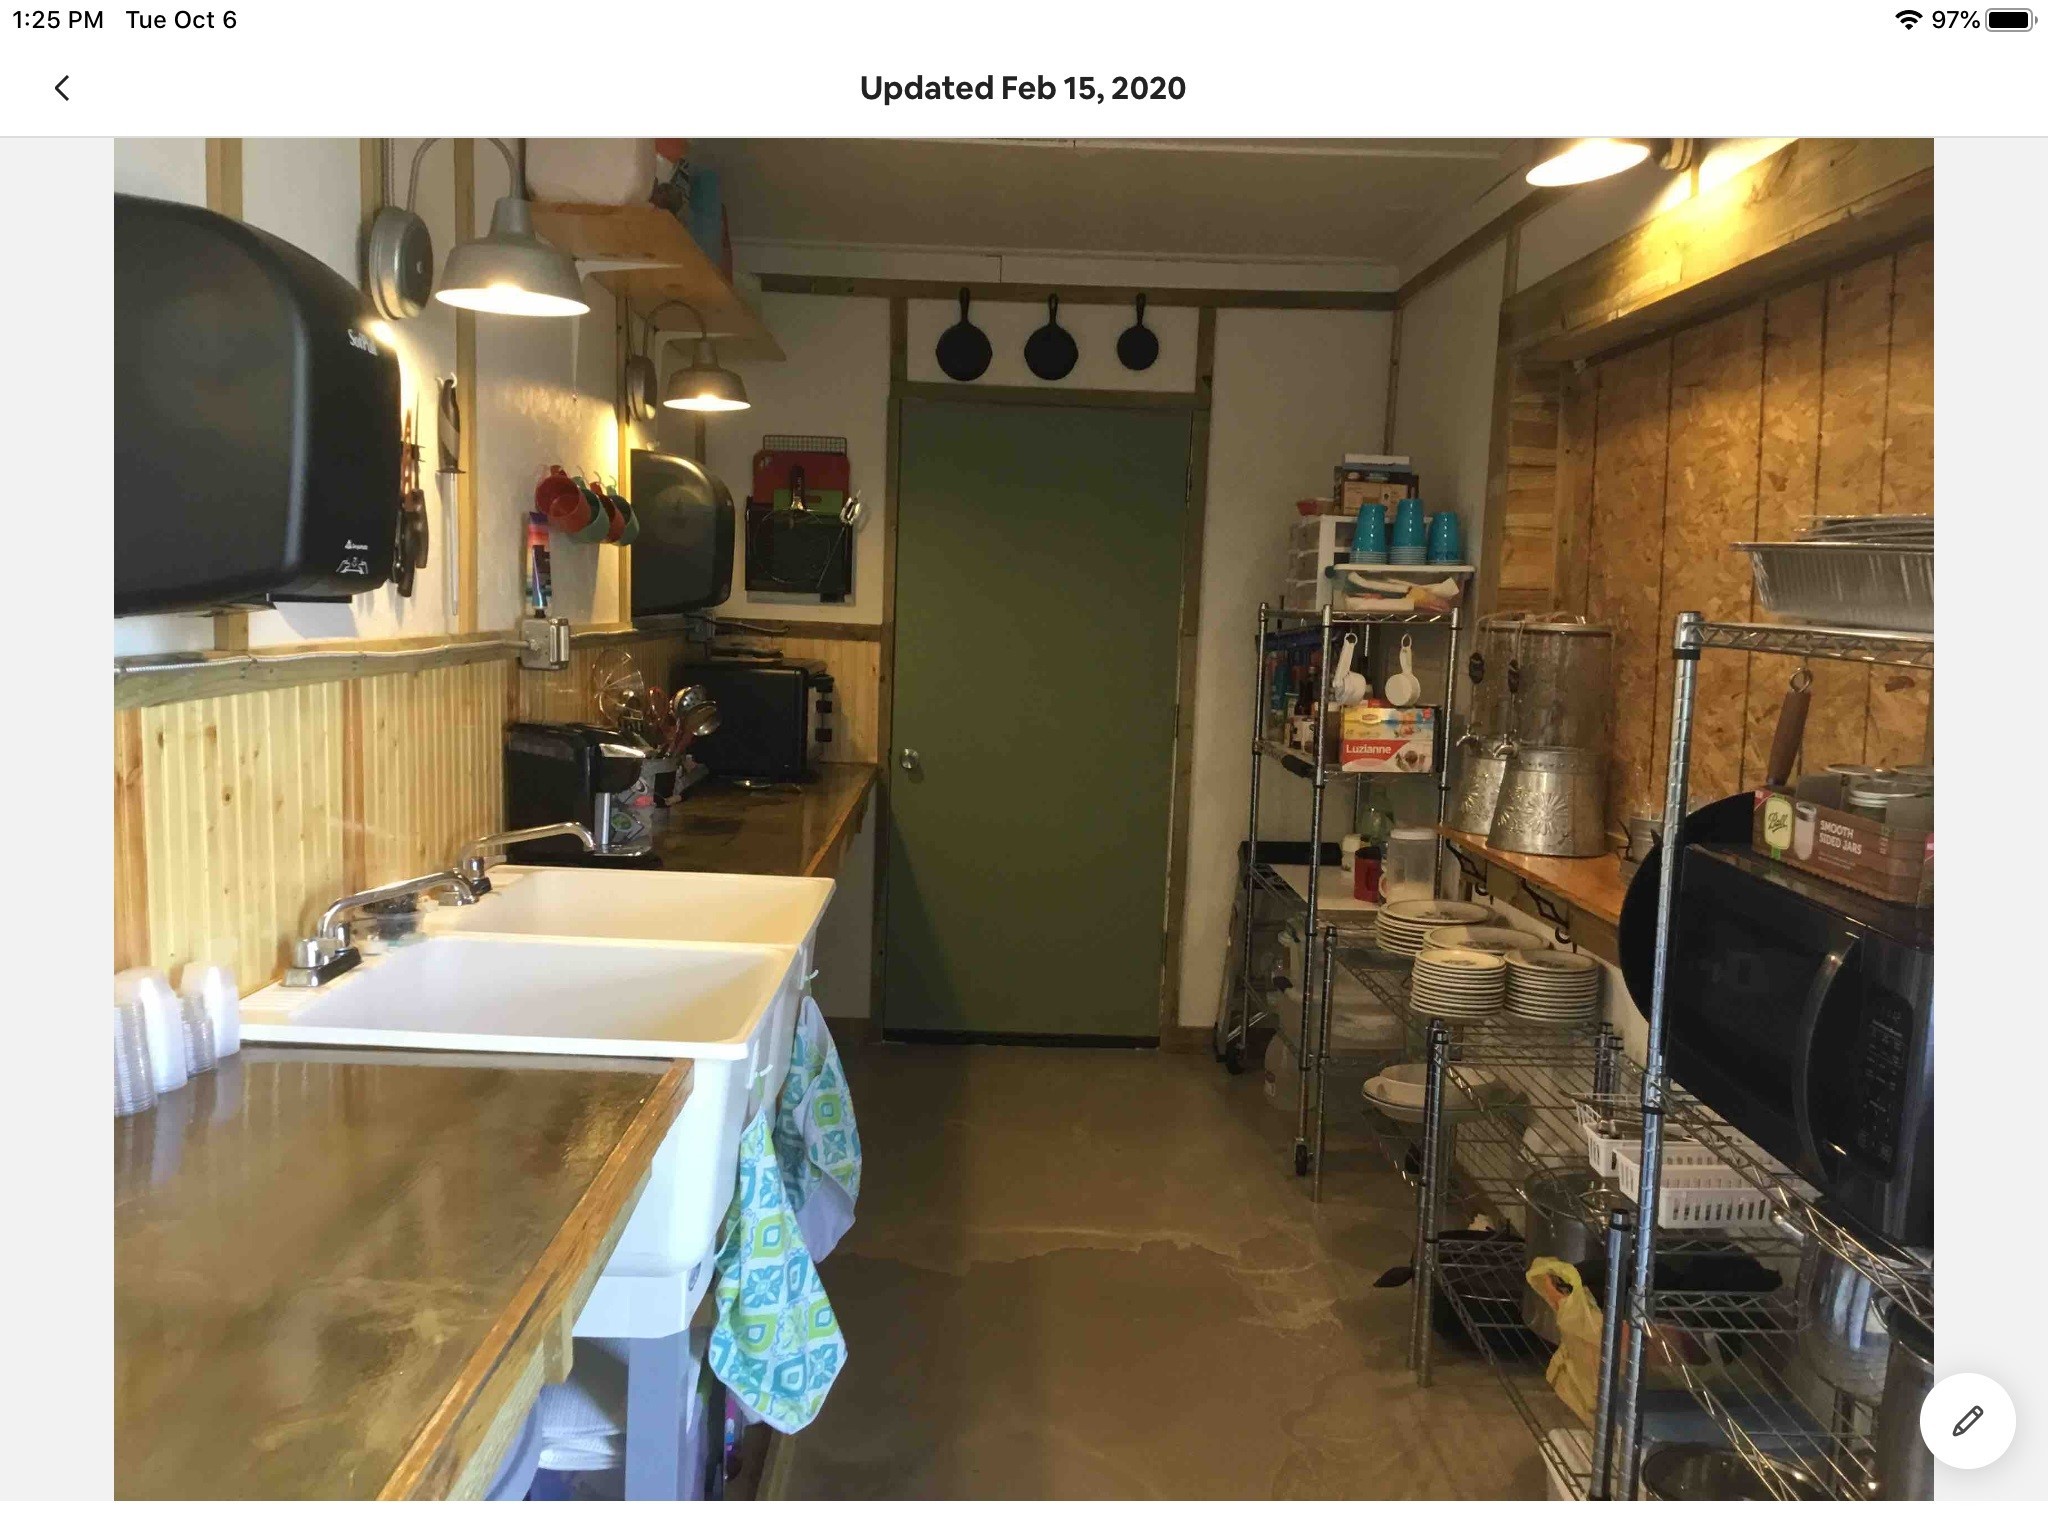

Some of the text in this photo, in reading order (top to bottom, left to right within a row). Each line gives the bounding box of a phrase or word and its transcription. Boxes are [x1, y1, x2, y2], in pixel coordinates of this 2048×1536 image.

[1346, 744, 1392, 754] Luzianne
[1767, 811, 1789, 831] Ball
[1819, 819, 1854, 839] SMOOTH
[1819, 833, 1842, 849] SIDED
[1842, 838, 1862, 856] JARS
